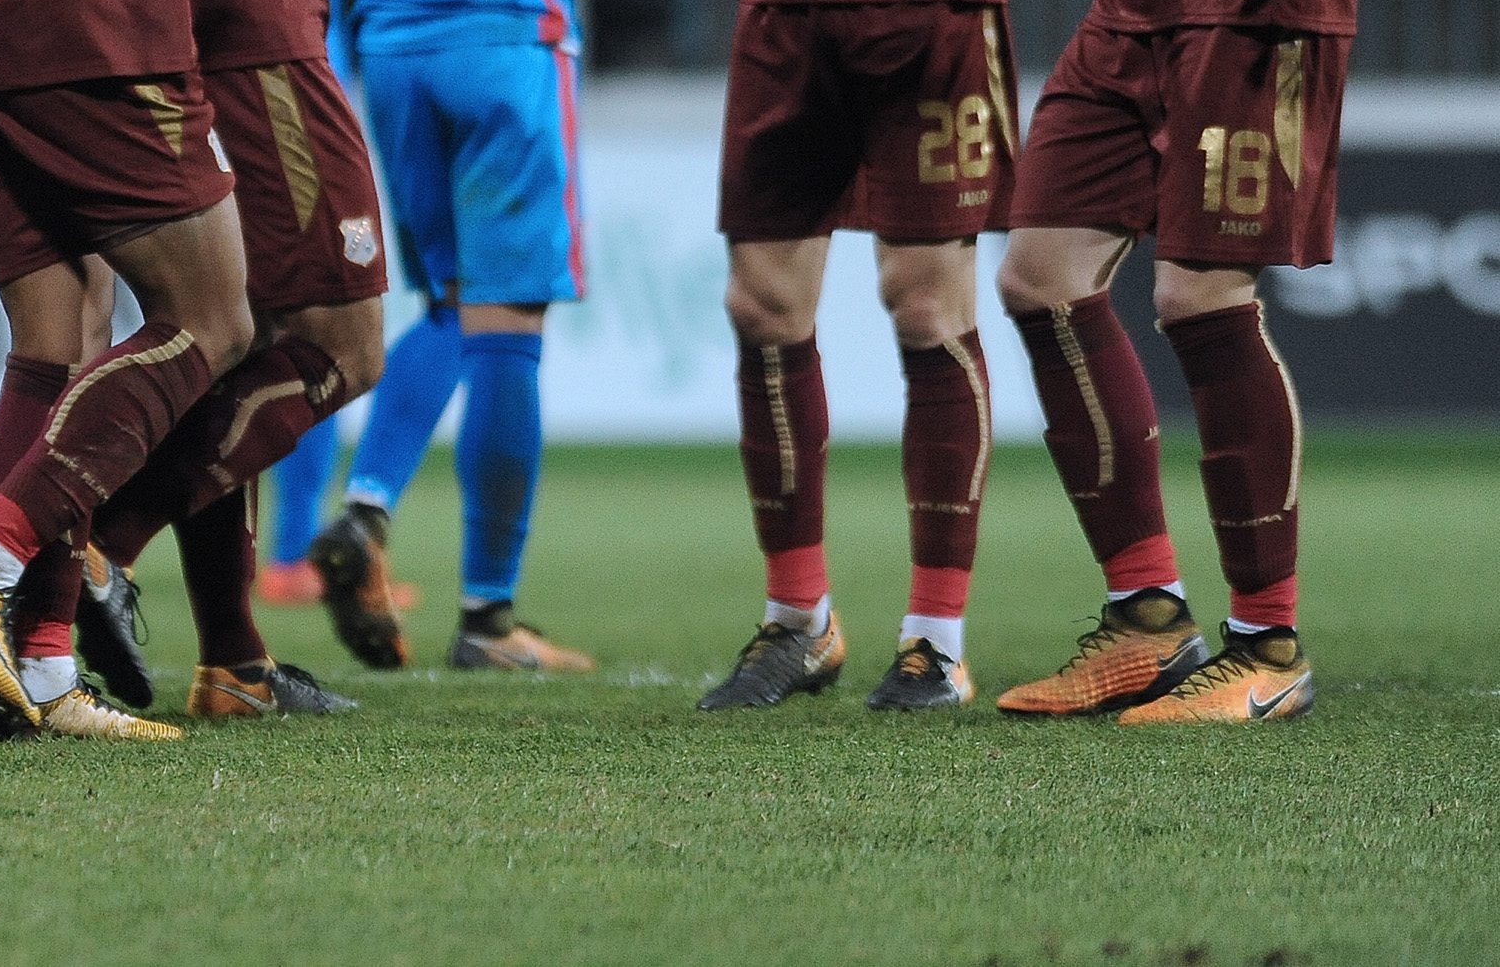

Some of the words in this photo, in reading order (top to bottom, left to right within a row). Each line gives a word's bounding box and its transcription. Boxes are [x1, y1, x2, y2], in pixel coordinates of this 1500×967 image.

[917, 95, 993, 184] 28
[1197, 125, 1272, 215] 18
[956, 189, 989, 208] JAKO
[1219, 219, 1262, 236] JAKO
